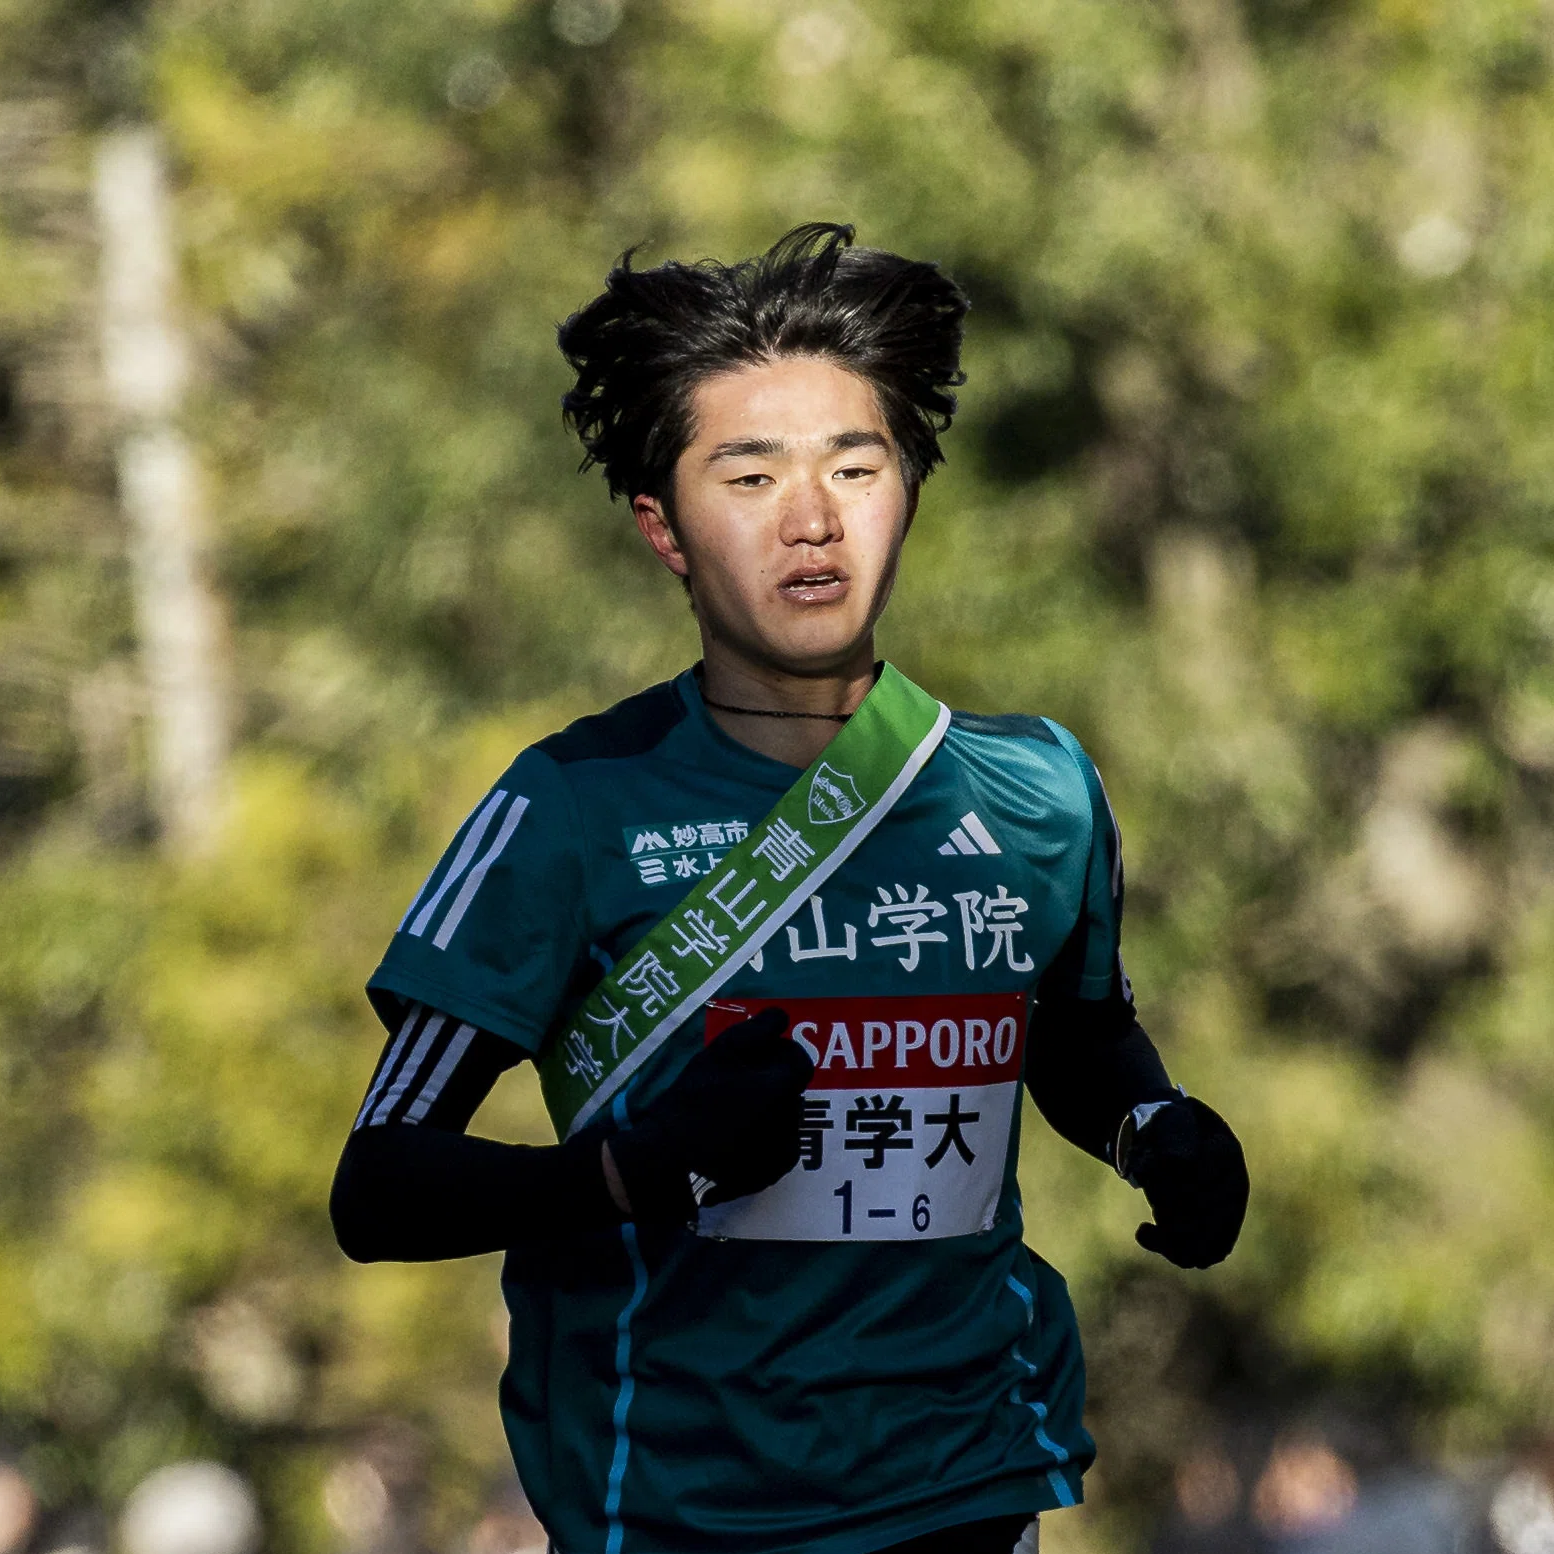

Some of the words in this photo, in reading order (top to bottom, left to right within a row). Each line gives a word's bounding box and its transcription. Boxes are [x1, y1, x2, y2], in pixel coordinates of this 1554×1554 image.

[671, 819, 749, 849] 妙高市
[564, 816, 817, 1090] 青山学院大学
[748, 883, 1035, 973] 山学院
[791, 1016, 1018, 1070] SAPPORO
